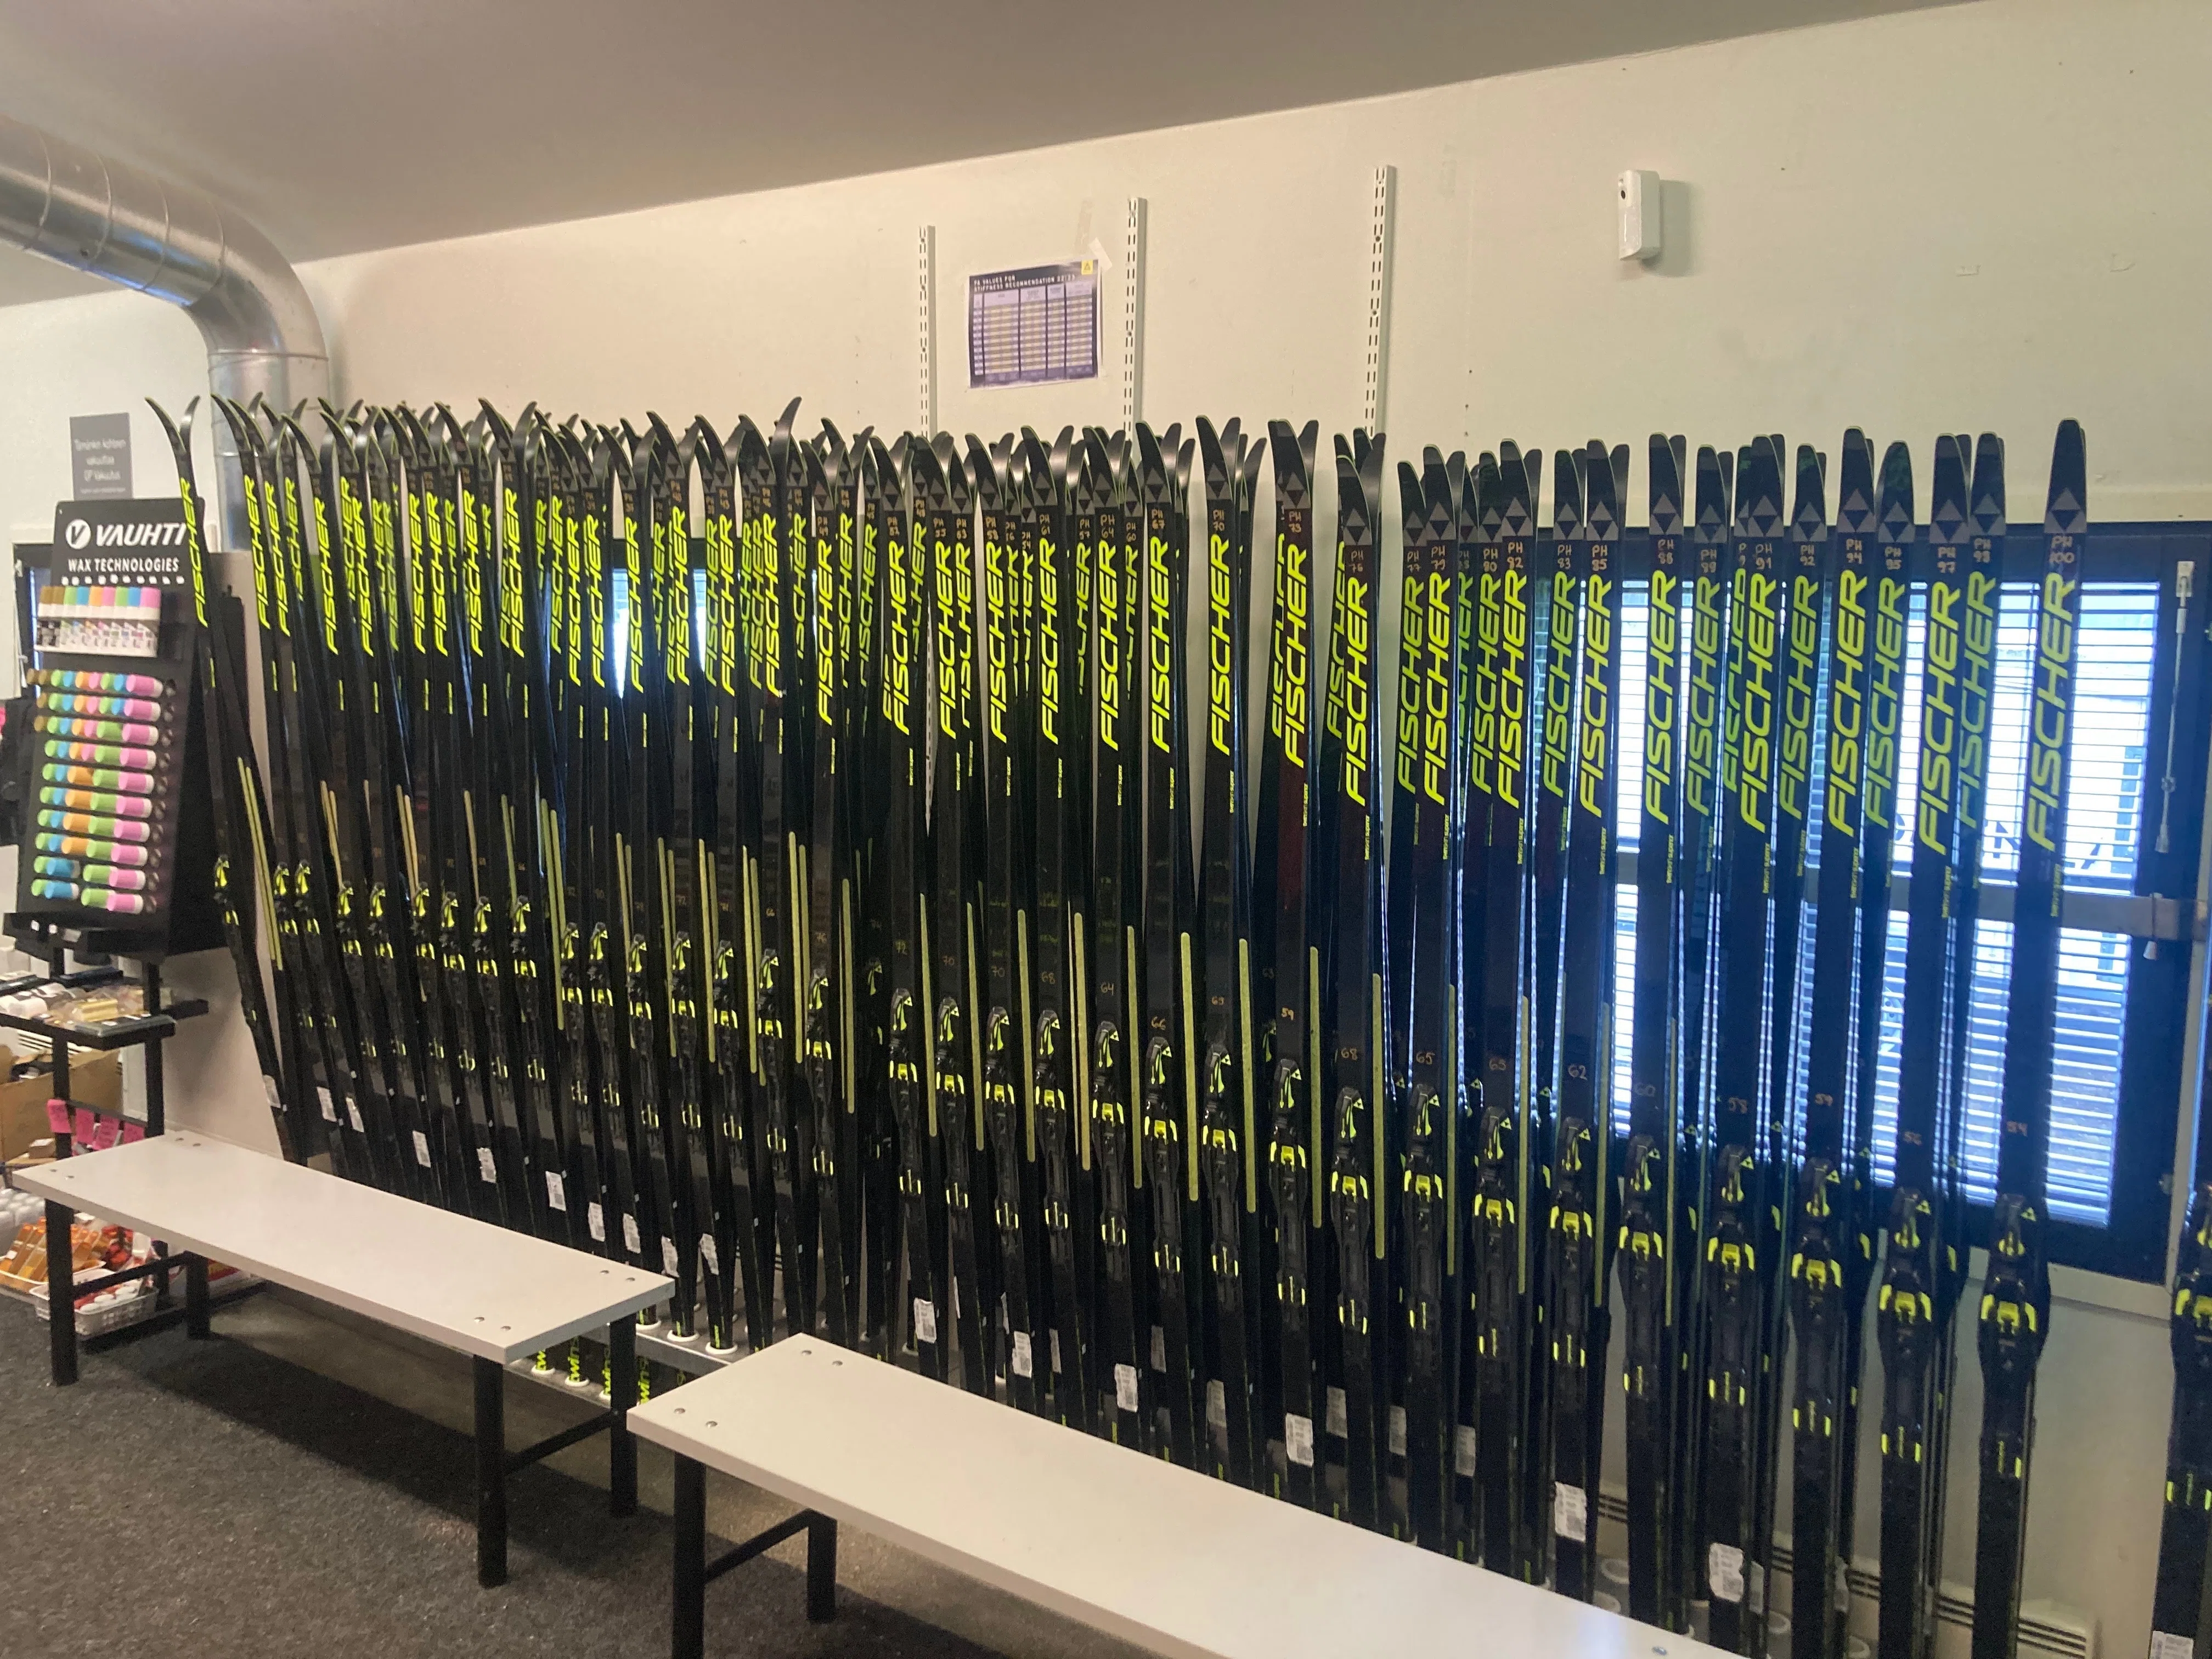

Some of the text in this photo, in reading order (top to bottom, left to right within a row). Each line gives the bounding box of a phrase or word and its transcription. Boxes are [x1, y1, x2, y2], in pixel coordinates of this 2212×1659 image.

[68, 557, 179, 573] WAX TECHNOLOGIES
[96, 522, 188, 547] VAUHTI
[180, 478, 207, 627] FISCHER
[244, 475, 270, 629] FISCHER
[264, 481, 291, 637] FISCHER
[314, 497, 338, 654] FISCHER
[352, 497, 374, 657] FISCHER
[409, 493, 426, 654] FISCHER
[426, 492, 448, 657] FISCHER
[463, 489, 483, 657] FISCHER
[505, 488, 524, 658] FISCHER
[551, 495, 563, 654] FISCHER
[933, 517, 944, 528] PH
[985, 516, 997, 528] PH
[1039, 513, 1050, 524] PH
[1079, 518, 1091, 530] PH
[1099, 514, 1115, 527] PH
[1101, 527, 1115, 539] 64
[1126, 522, 1137, 532] PH
[1152, 509, 1164, 519] PH
[1152, 520, 1165, 530] 67
[1212, 509, 1225, 521] PH
[1212, 522, 1225, 532] 70
[1289, 511, 1302, 522] PH
[1350, 550, 1364, 562] PH
[1407, 550, 1420, 562] PH
[1407, 563, 1421, 573] 77
[1430, 558, 1446, 571] 79
[1431, 545, 1446, 558] PH
[1483, 548, 1498, 560] PH
[1508, 541, 1523, 554] PH
[1557, 544, 1572, 557] PH
[1557, 557, 1571, 570] 83
[1592, 544, 1608, 558] PH
[1592, 558, 1608, 572] 85
[1657, 538, 1674, 551] PH
[1700, 549, 1717, 561] PH
[1755, 542, 1773, 555] PH
[1755, 556, 1772, 571] 91
[1800, 544, 1815, 556] PH
[1846, 538, 1863, 551] PH
[1846, 552, 1863, 565] 94
[1884, 546, 1902, 558] PH
[1937, 546, 1956, 559] PH
[1973, 538, 1992, 550] PH
[2051, 535, 2073, 549] PH
[566, 517, 581, 686] FISCHER
[588, 514, 605, 688] FISCHER
[625, 517, 644, 693] FISCHER
[672, 506, 690, 686] FISCHER
[706, 518, 718, 686] FISCHER
[719, 514, 735, 697] FISCHER
[750, 519, 764, 689] FISCHER
[763, 513, 780, 698] FISCHER
[816, 539, 833, 726] FISCHER
[888, 540, 910, 736] FISCHER
[935, 541, 957, 740] FISCHER
[986, 541, 1007, 744] FISCHER
[1039, 538, 1059, 745] FISCHER
[1098, 539, 1119, 751] FISCHER
[1150, 536, 1170, 753] FISCHER
[1210, 533, 1229, 756] FISCHER
[1285, 543, 1307, 768] FISCHER
[1346, 577, 1369, 806] FISCHER
[1398, 575, 1425, 794] FISCHER
[1424, 571, 1451, 806] FISCHER
[1471, 572, 1502, 794] FISCHER
[1497, 568, 1527, 809] FISCHER
[1542, 571, 1576, 798] FISCHER
[1579, 573, 1612, 818] FISCHER
[1645, 568, 1677, 825] FISCHER
[1686, 575, 1720, 817] FISCHER
[1741, 572, 1777, 833] FISCHER
[1779, 574, 1818, 821] FISCHER
[1827, 568, 1867, 837] FISCHER
[1865, 576, 1906, 829] FISCHER
[1919, 580, 1961, 856] FISCHER
[1958, 571, 1997, 830] FISCHER
[2026, 572, 2075, 852] FISCHER
[1101, 981, 1115, 996] 64
[1341, 1047, 1358, 1061] 68
[1415, 1051, 1436, 1065] 65
